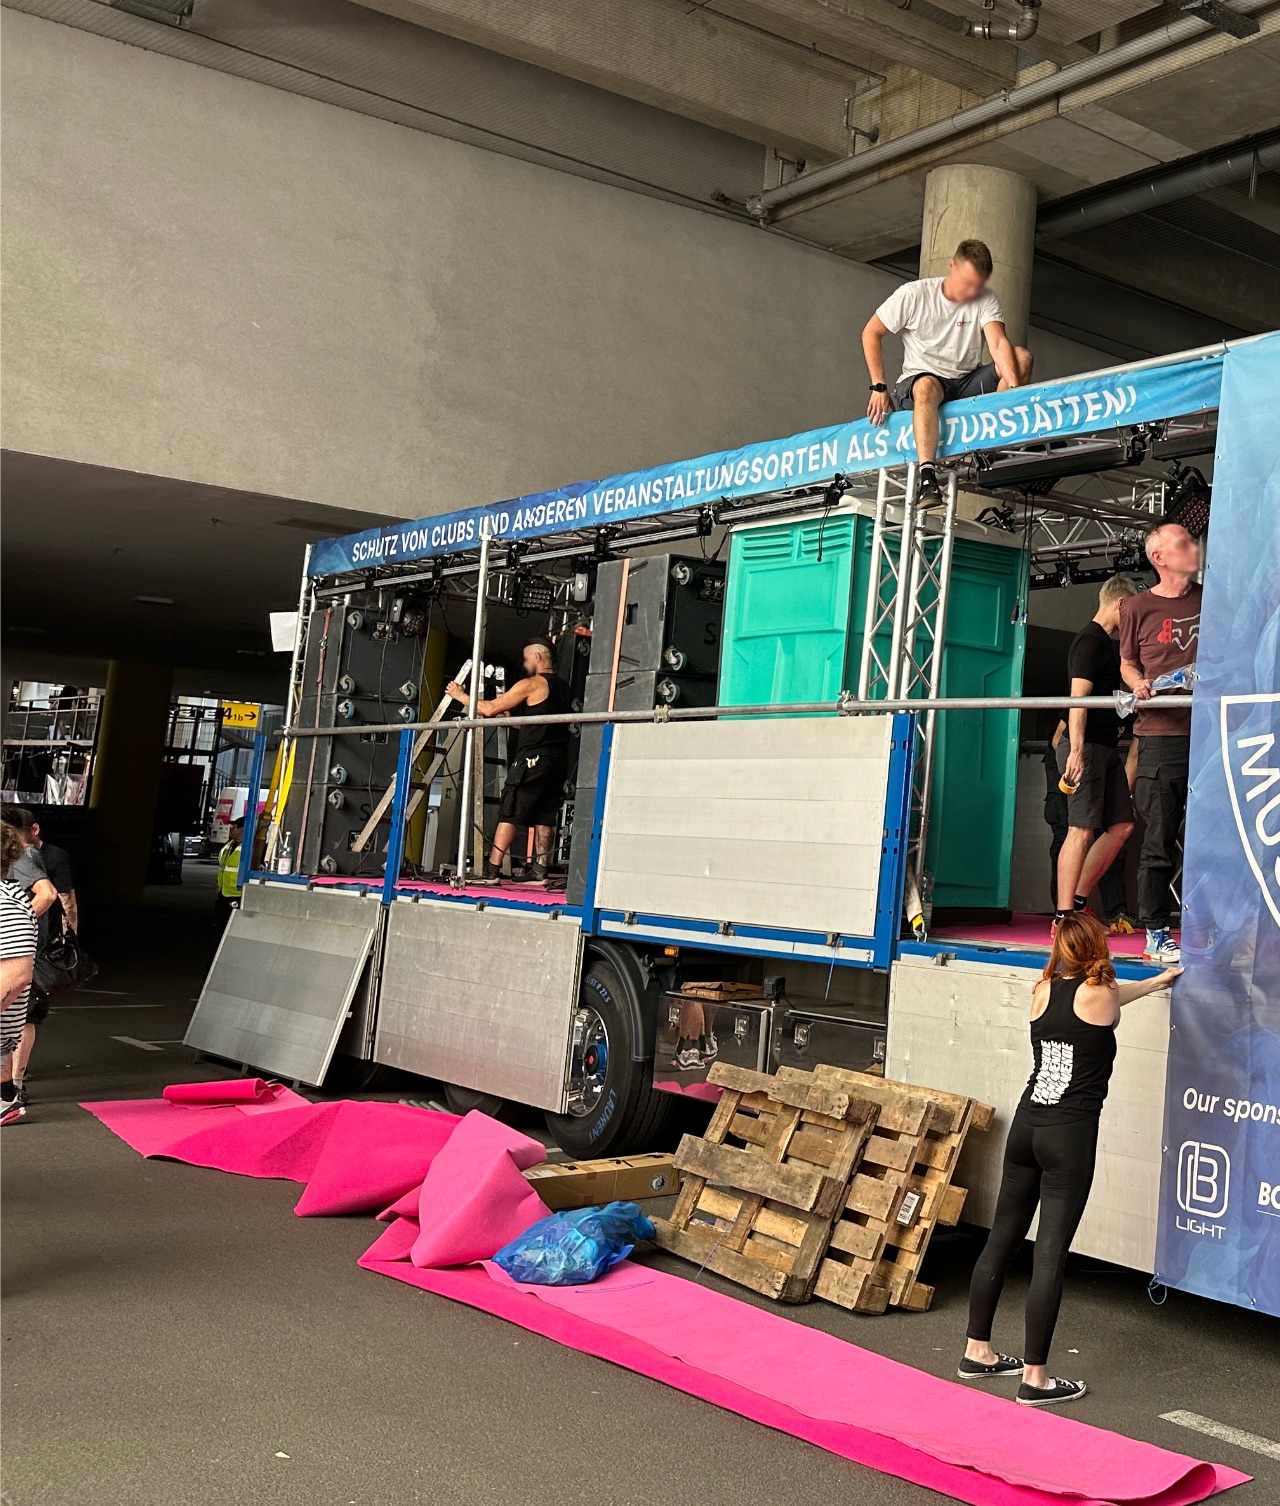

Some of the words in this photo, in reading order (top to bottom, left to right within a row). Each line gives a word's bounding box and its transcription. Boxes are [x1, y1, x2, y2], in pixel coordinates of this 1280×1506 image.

[353, 535, 398, 562] SCHUTZ
[402, 529, 428, 553] VON
[432, 518, 475, 546] CLUBS
[512, 495, 587, 532] ANDEREN
[593, 439, 838, 515] VERANSTALTUNGSORTEN
[846, 428, 889, 464] ALS
[896, 385, 1138, 452] KTURSTÄTTEN!
[1183, 1087, 1221, 1114] Our
[1175, 1216, 1227, 1240] LIGHT
